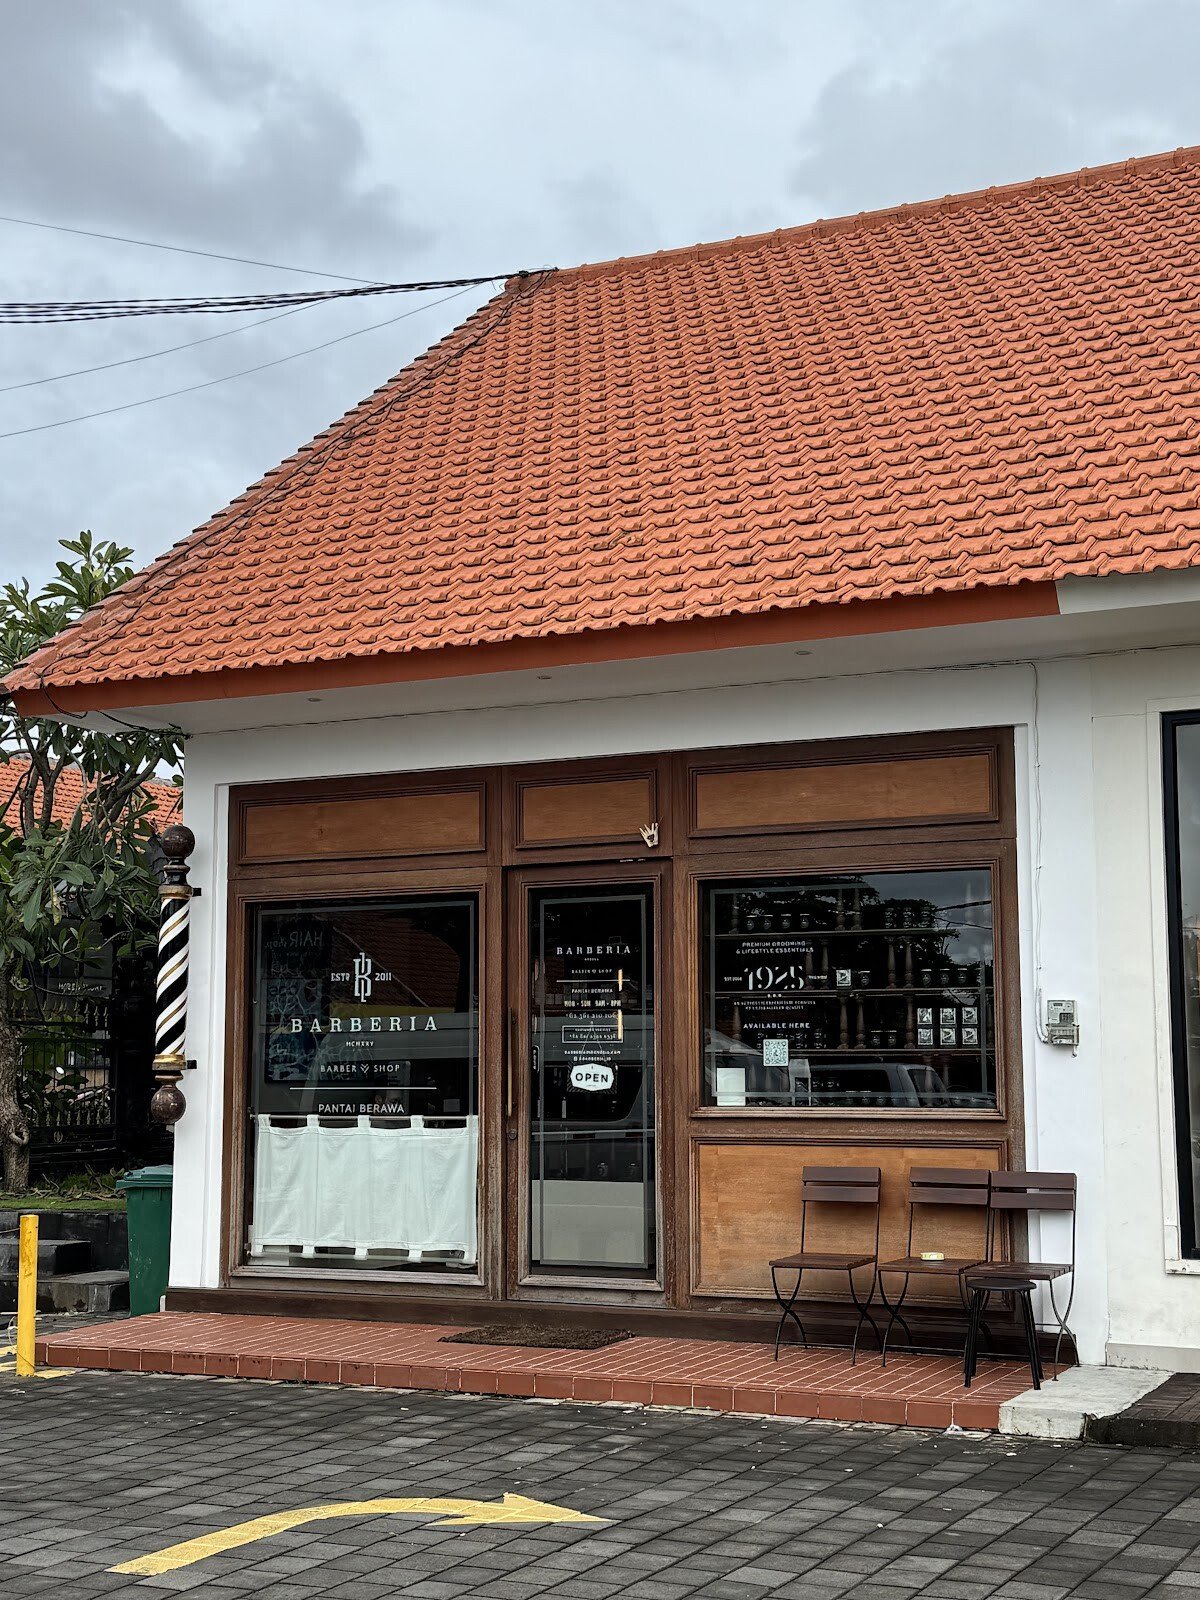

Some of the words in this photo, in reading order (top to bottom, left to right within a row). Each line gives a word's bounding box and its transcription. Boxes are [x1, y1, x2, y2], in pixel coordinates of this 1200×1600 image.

[556, 945, 631, 955] BARBERIA
[375, 972, 392, 981] 2011
[744, 965, 804, 990] 1925
[291, 1016, 438, 1033] BARBERIA
[320, 1065, 357, 1073] BARBER
[373, 1064, 400, 1073] SHOP
[575, 1072, 609, 1083] OPEN
[318, 1103, 356, 1113] PANTAI
[359, 1103, 405, 1113] BERAWA
